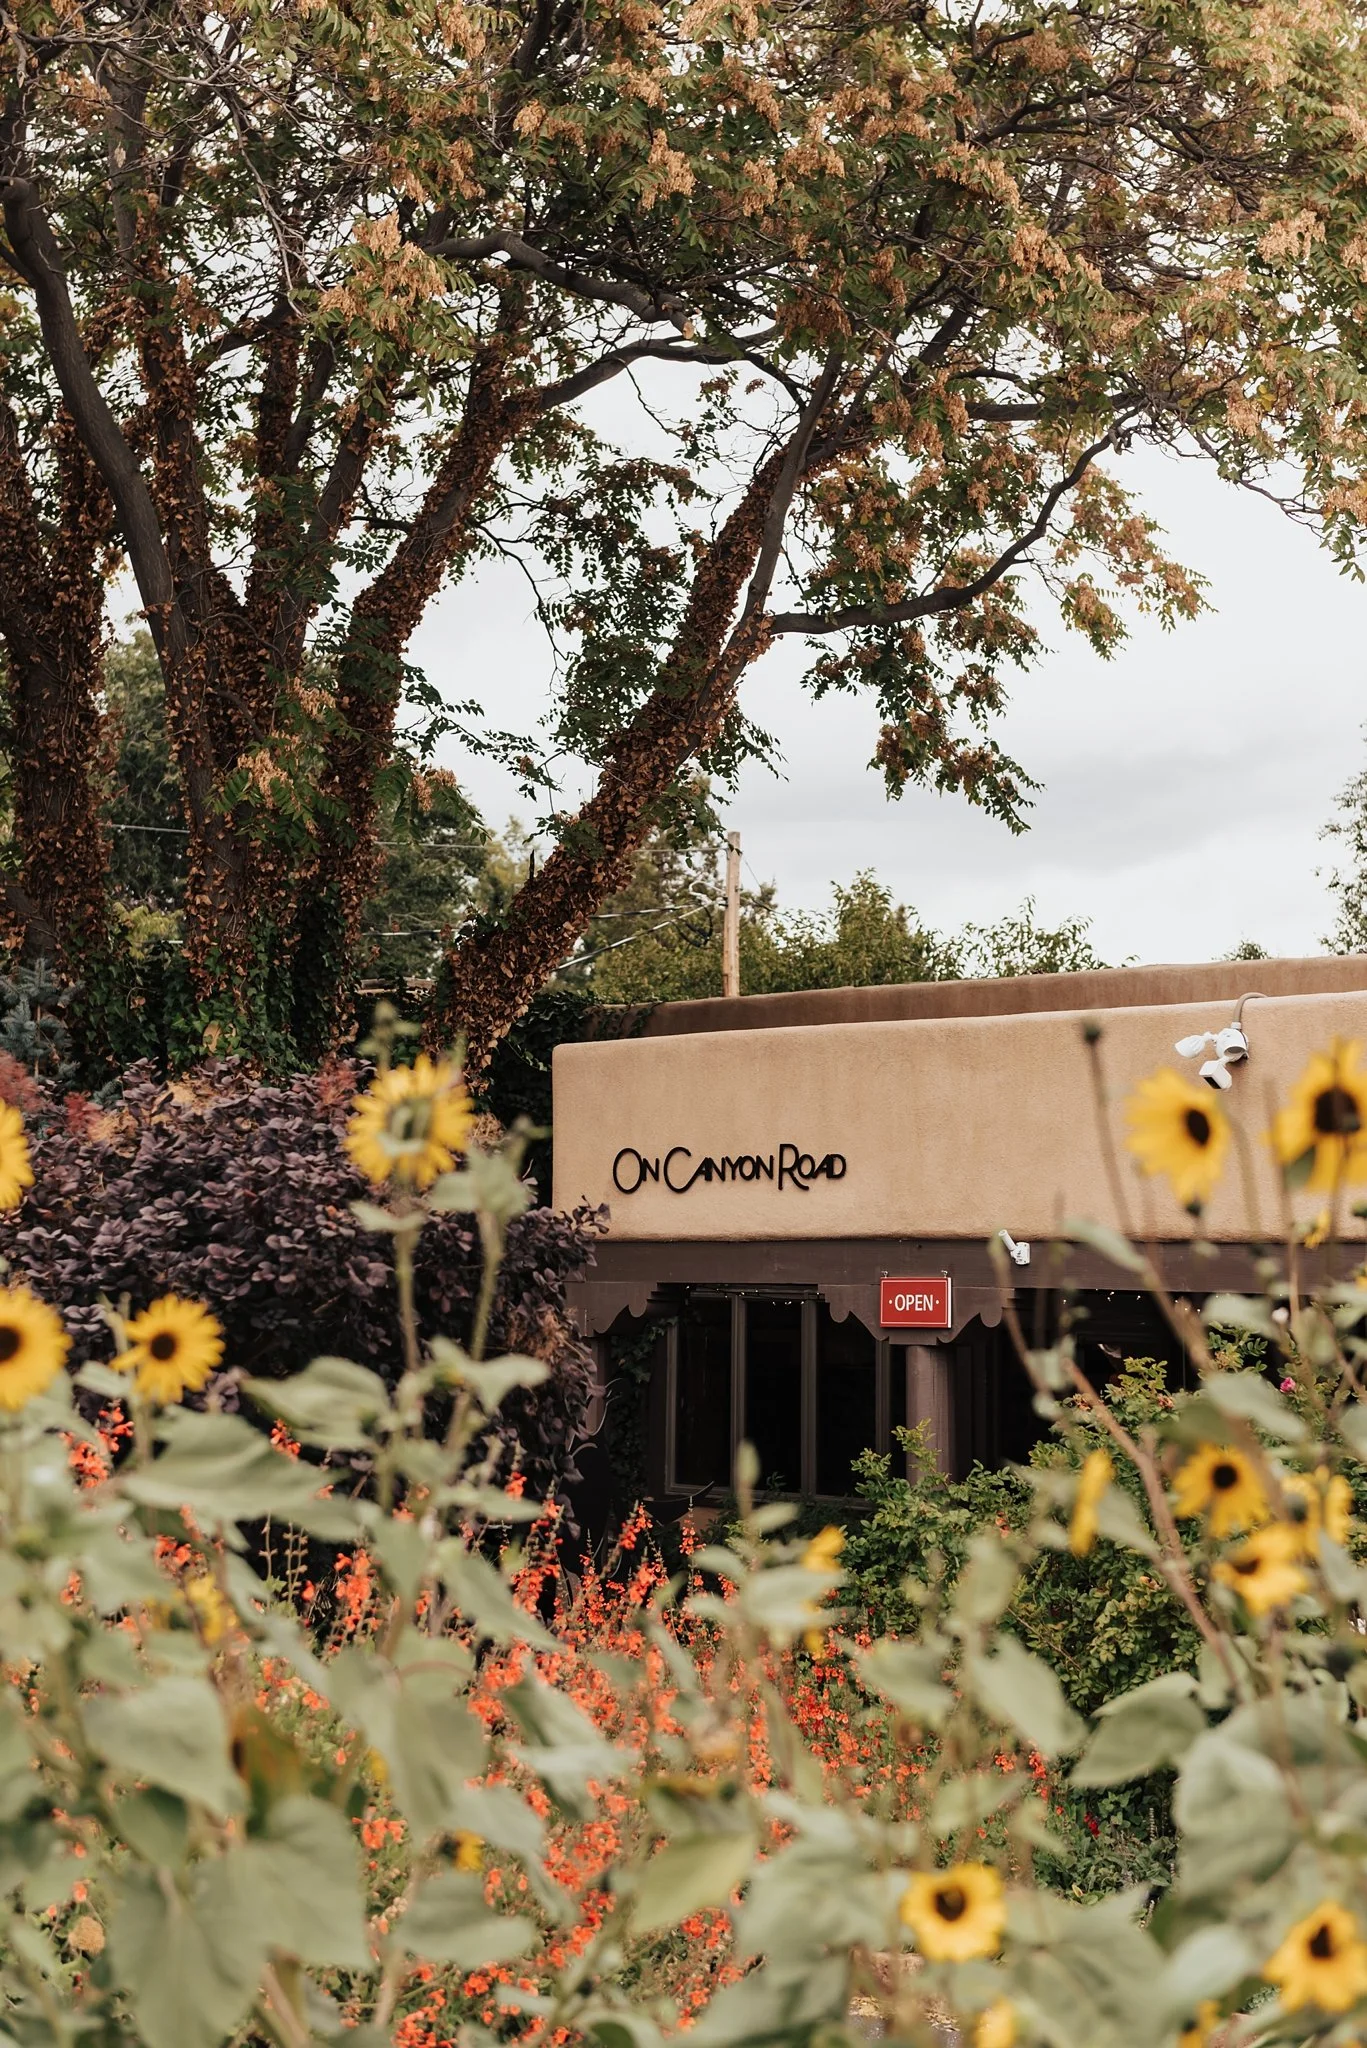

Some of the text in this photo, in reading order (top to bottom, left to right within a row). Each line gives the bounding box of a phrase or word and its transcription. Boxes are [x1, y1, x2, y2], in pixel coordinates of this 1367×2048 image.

[613, 1143, 847, 1194] ON CANYON ROAD
[894, 1294, 934, 1312] OPEN
